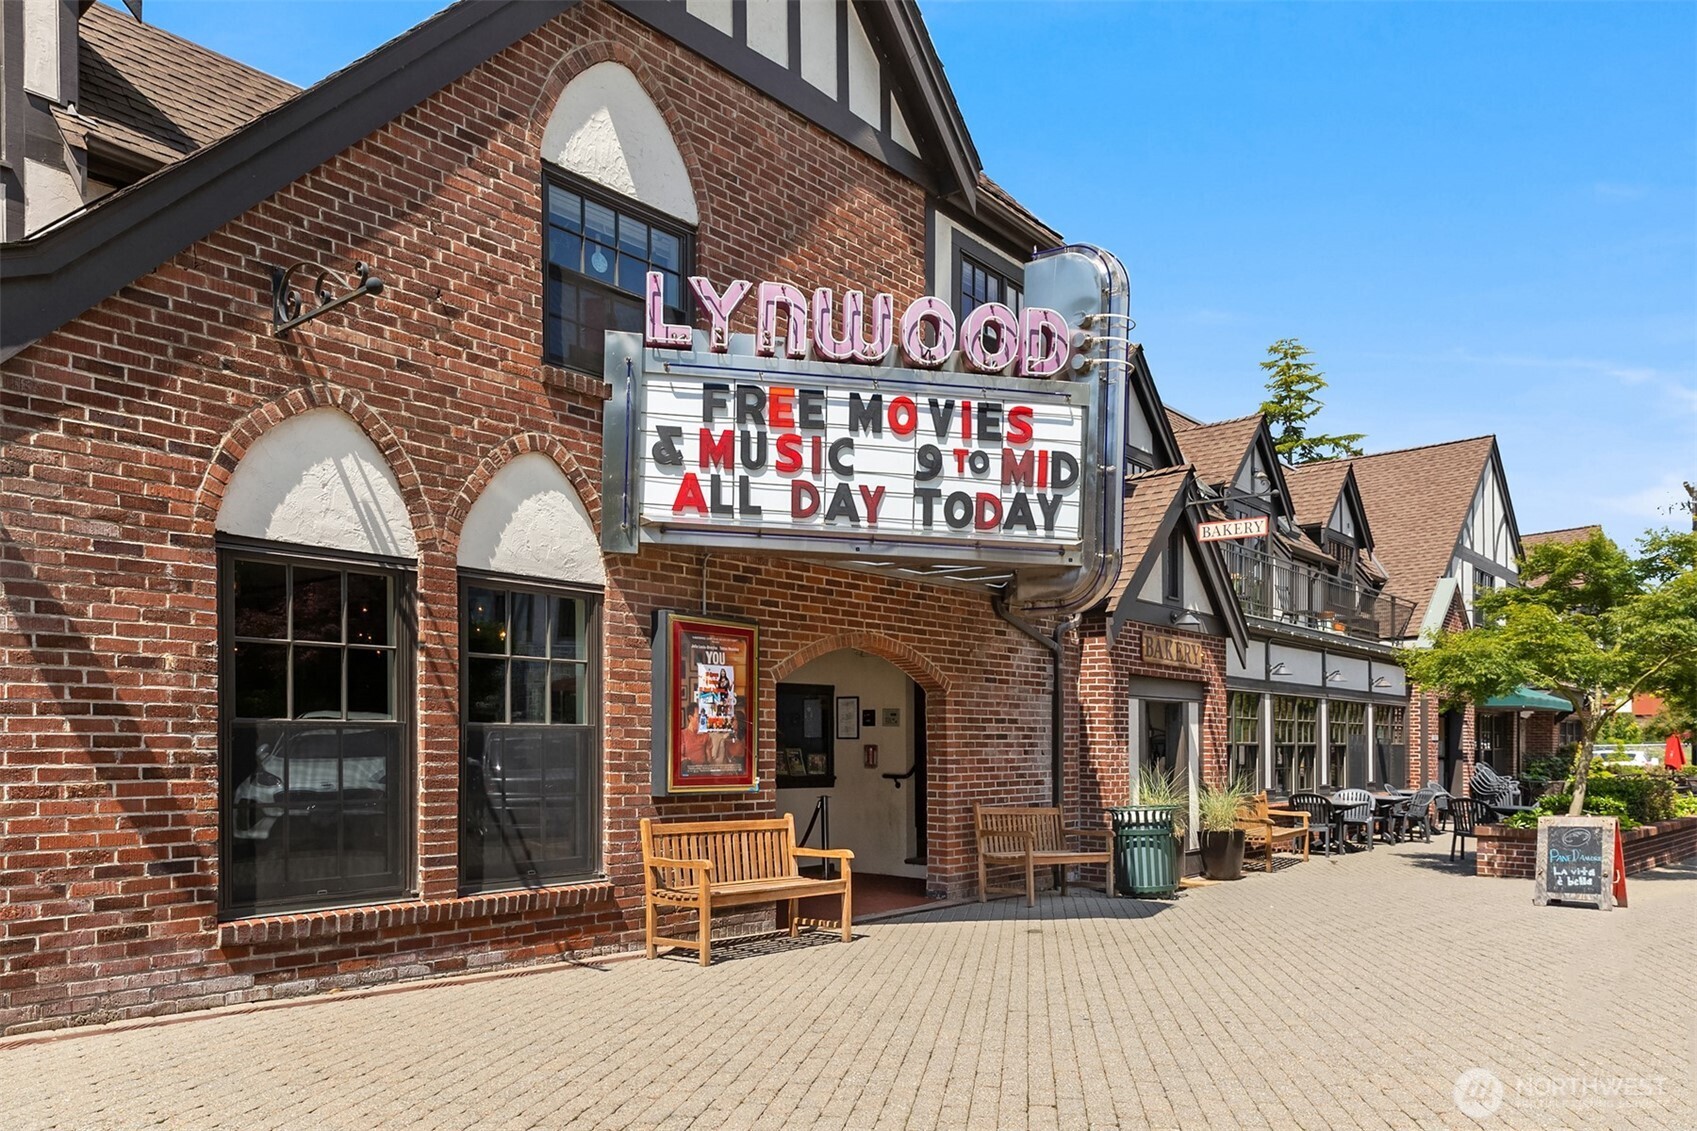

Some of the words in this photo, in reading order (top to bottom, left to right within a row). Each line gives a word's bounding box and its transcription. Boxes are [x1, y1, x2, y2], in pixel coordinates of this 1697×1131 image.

[645, 271, 1070, 378] LYNWOOD
[702, 382, 825, 430] FREE
[849, 392, 1034, 445] MOVIES
[651, 425, 684, 466] &
[699, 427, 854, 476] MUSIC
[914, 443, 943, 481] 9
[953, 448, 990, 475] TO
[1001, 447, 1079, 489] MID
[671, 472, 762, 516] ALL
[791, 479, 886, 524] DAY
[914, 487, 1063, 532] TODAY
[1202, 520, 1264, 538] BAKERY
[705, 650, 726, 665] YOU
[1144, 635, 1200, 666] BAKERY
[1567, 876, 1593, 887] bella
